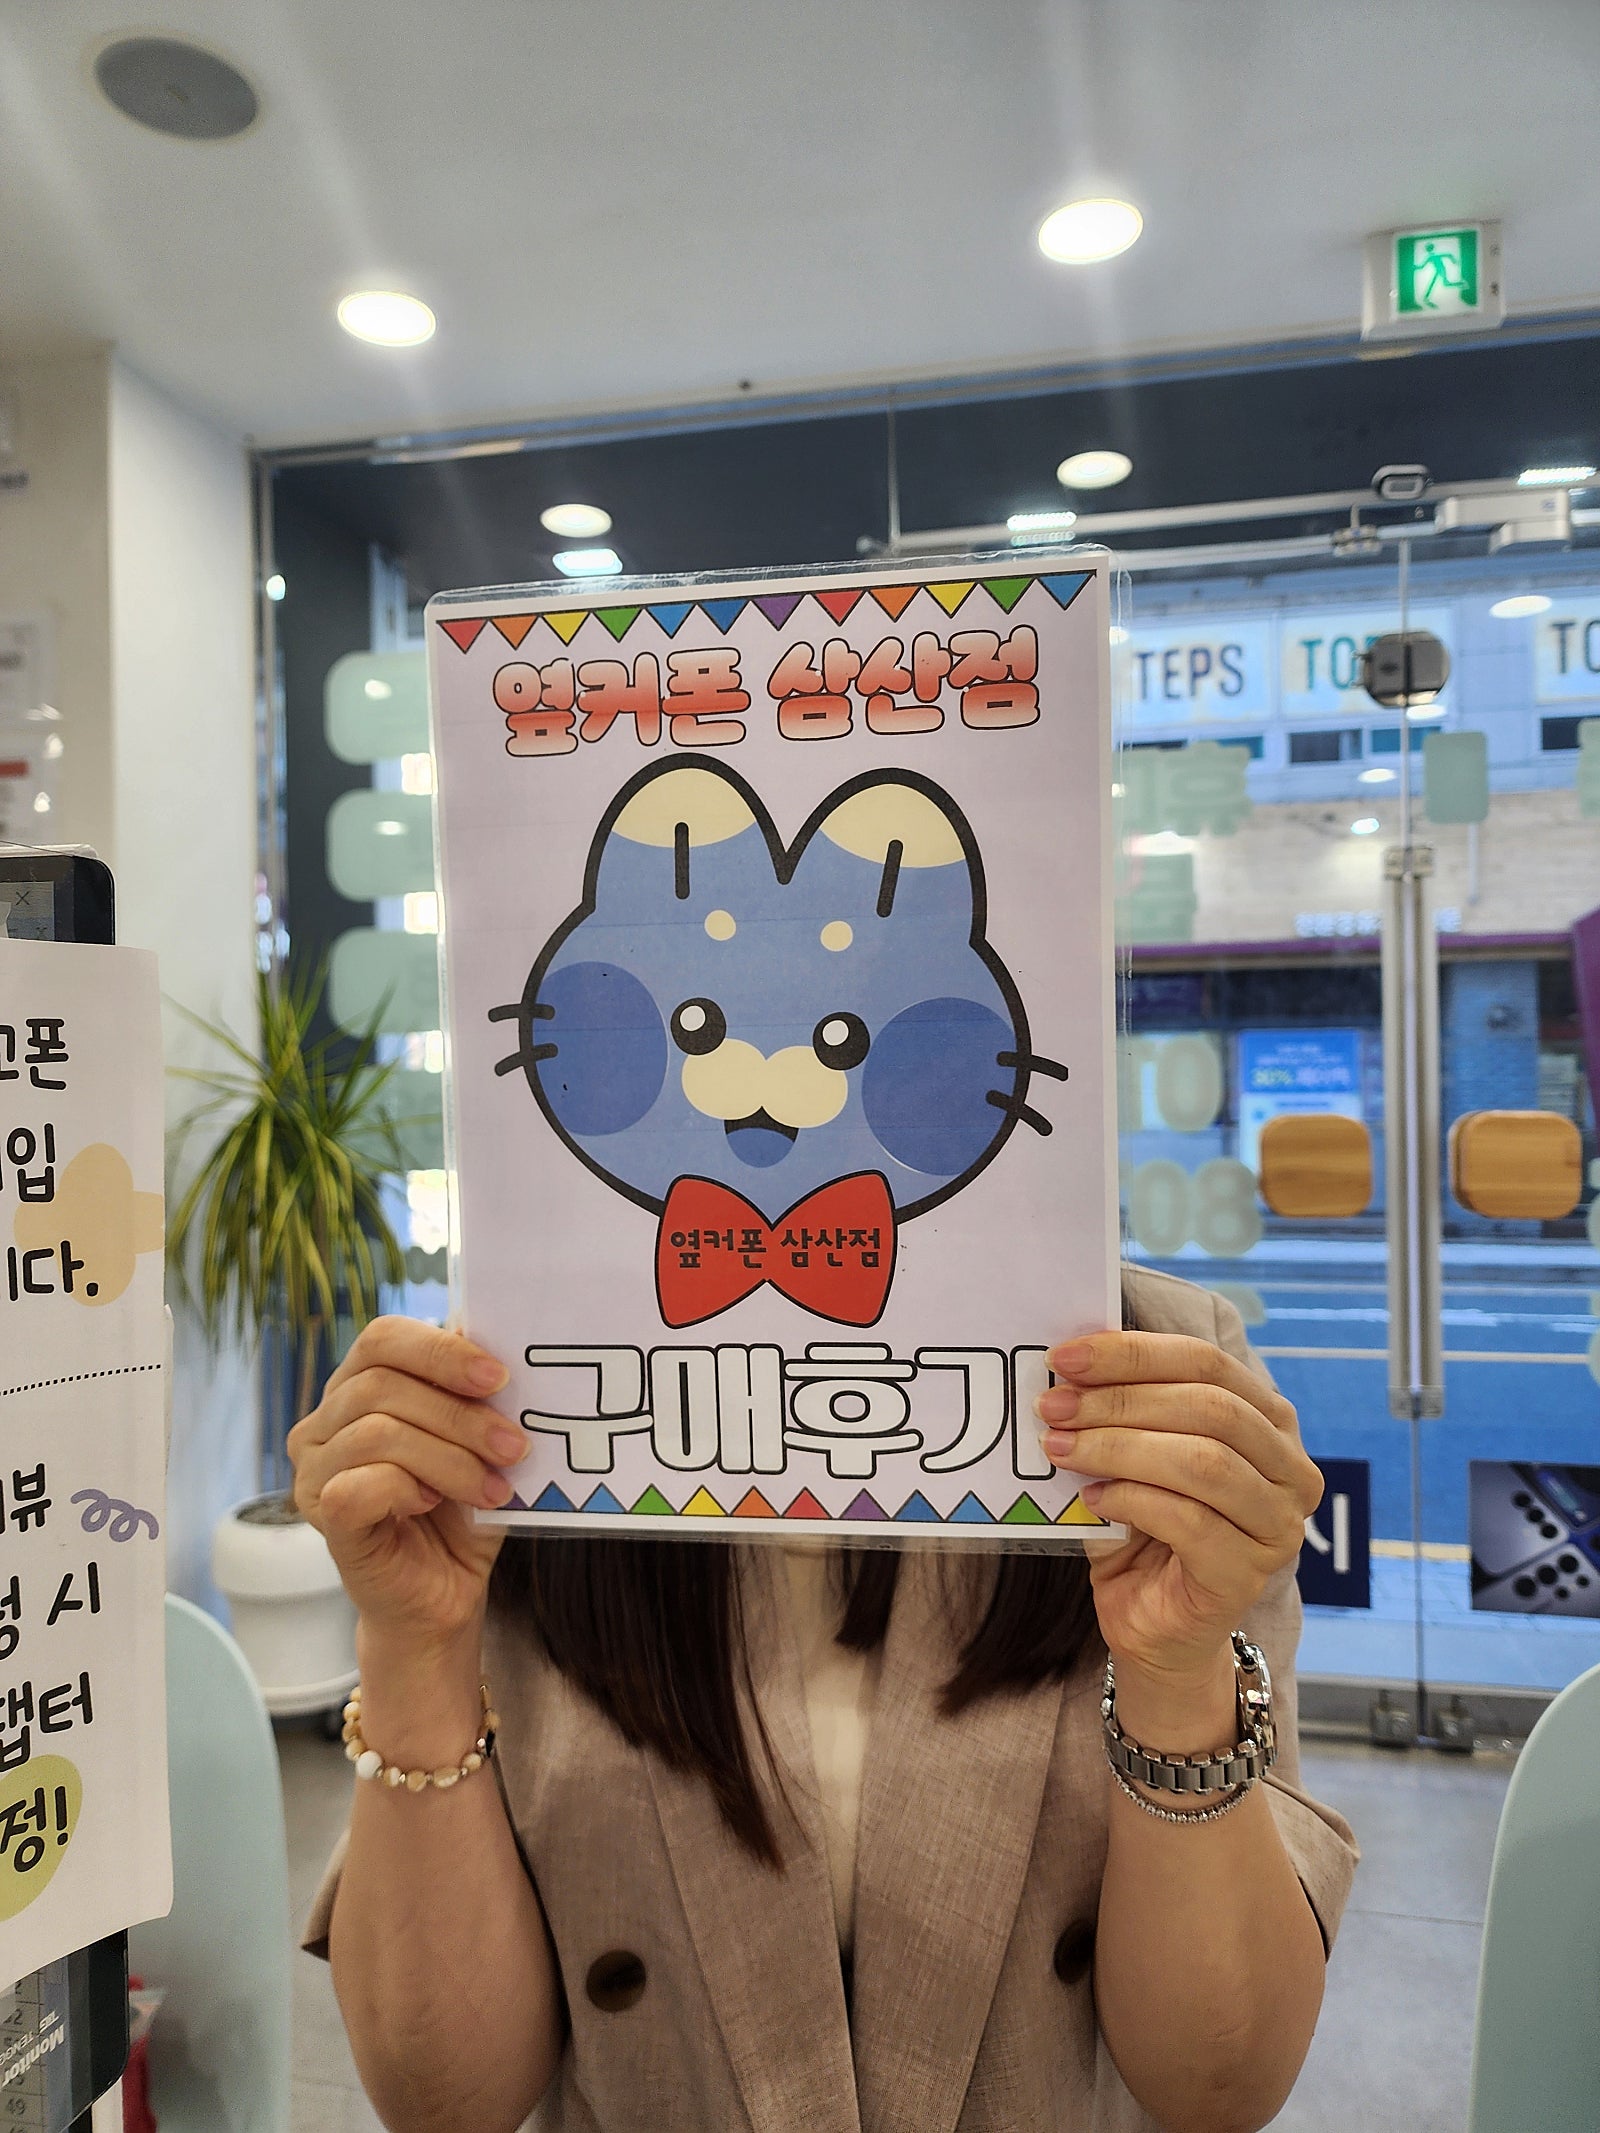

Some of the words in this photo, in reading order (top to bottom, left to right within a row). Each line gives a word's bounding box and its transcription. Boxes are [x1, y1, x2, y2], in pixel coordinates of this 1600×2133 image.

[493, 647, 752, 757] 옆커폰
[767, 624, 1040, 742] 삼산점
[1135, 644, 1246, 700] TEPS
[1299, 635, 1380, 690] TO
[0, 1123, 56, 1203] 입
[670, 1228, 767, 1269] 옆커폰
[780, 1227, 881, 1268] 삼산점
[520, 1341, 1058, 1480] 구매후기
[0, 1463, 52, 1534] 뷰
[47, 1561, 101, 1627] 시
[2, 2024, 65, 2088] Monitor
